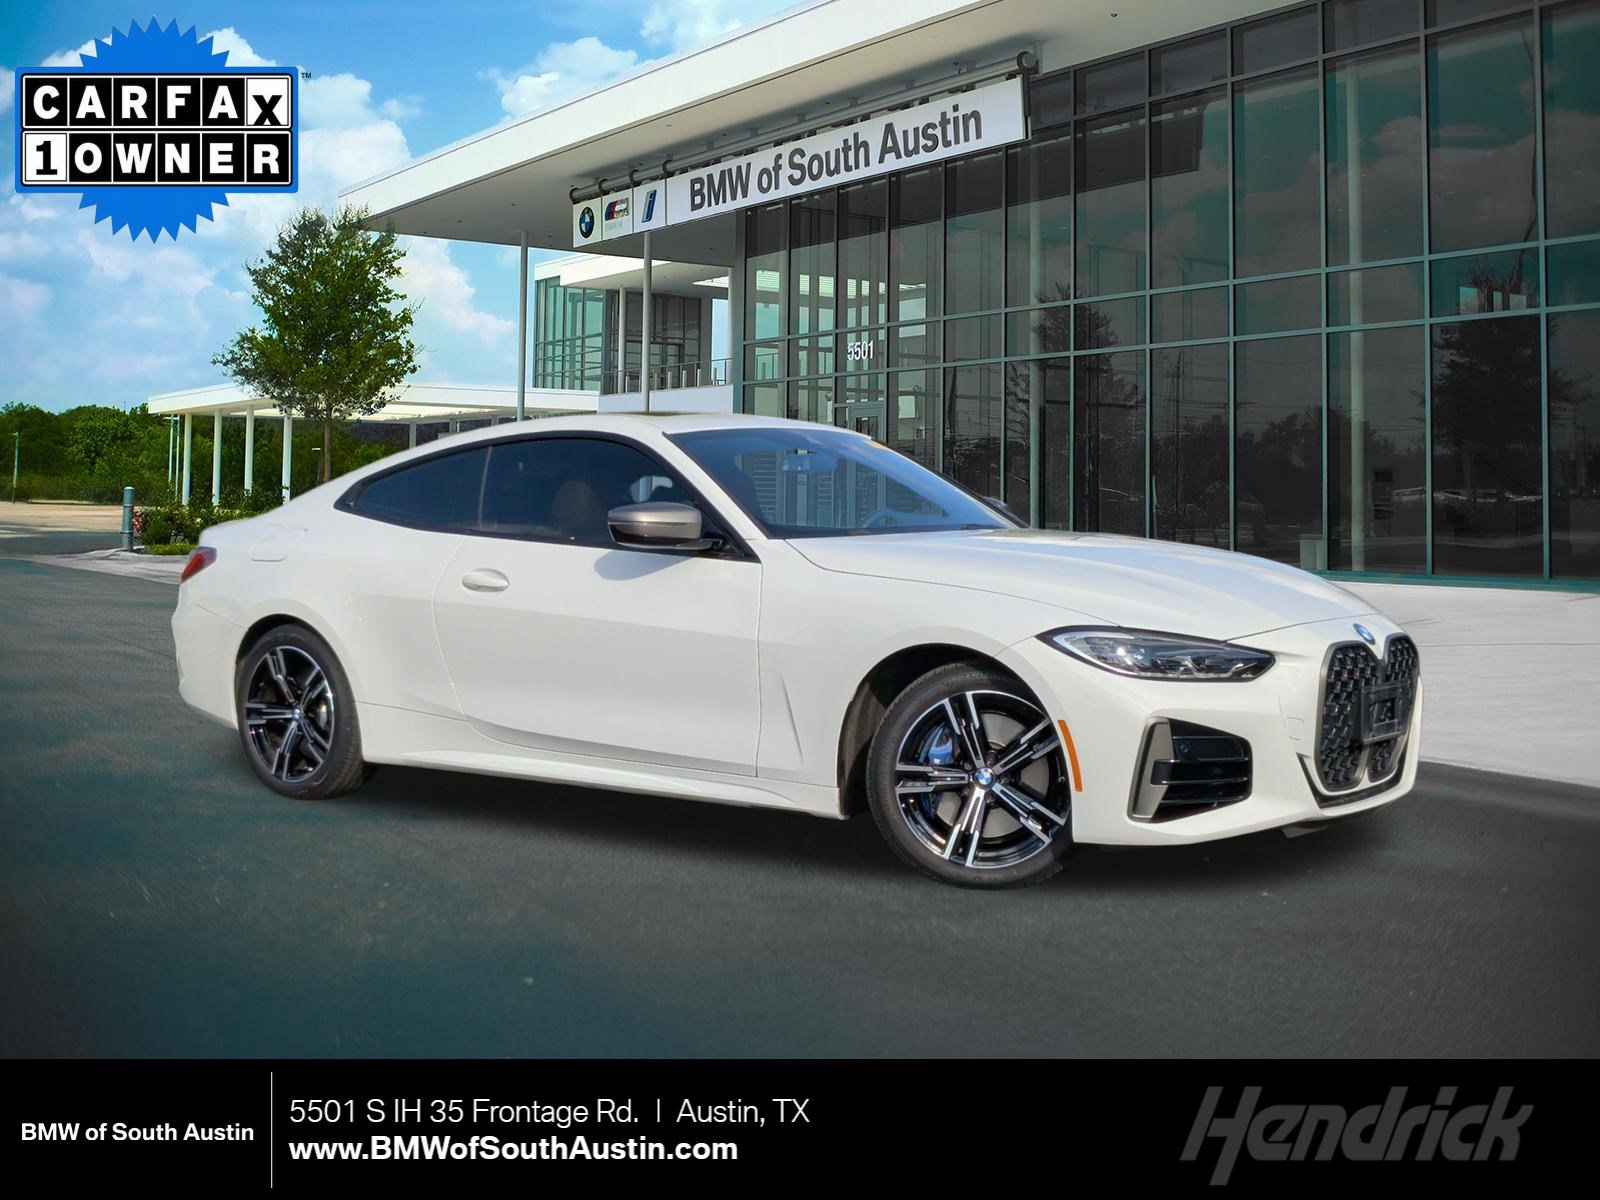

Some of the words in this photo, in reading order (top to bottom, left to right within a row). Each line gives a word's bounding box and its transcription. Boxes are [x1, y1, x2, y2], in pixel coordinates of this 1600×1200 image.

[690, 162, 752, 212] BMW
[757, 153, 782, 194] of
[787, 131, 870, 186] South
[878, 103, 982, 164] Austin
[847, 340, 874, 361] 5501
